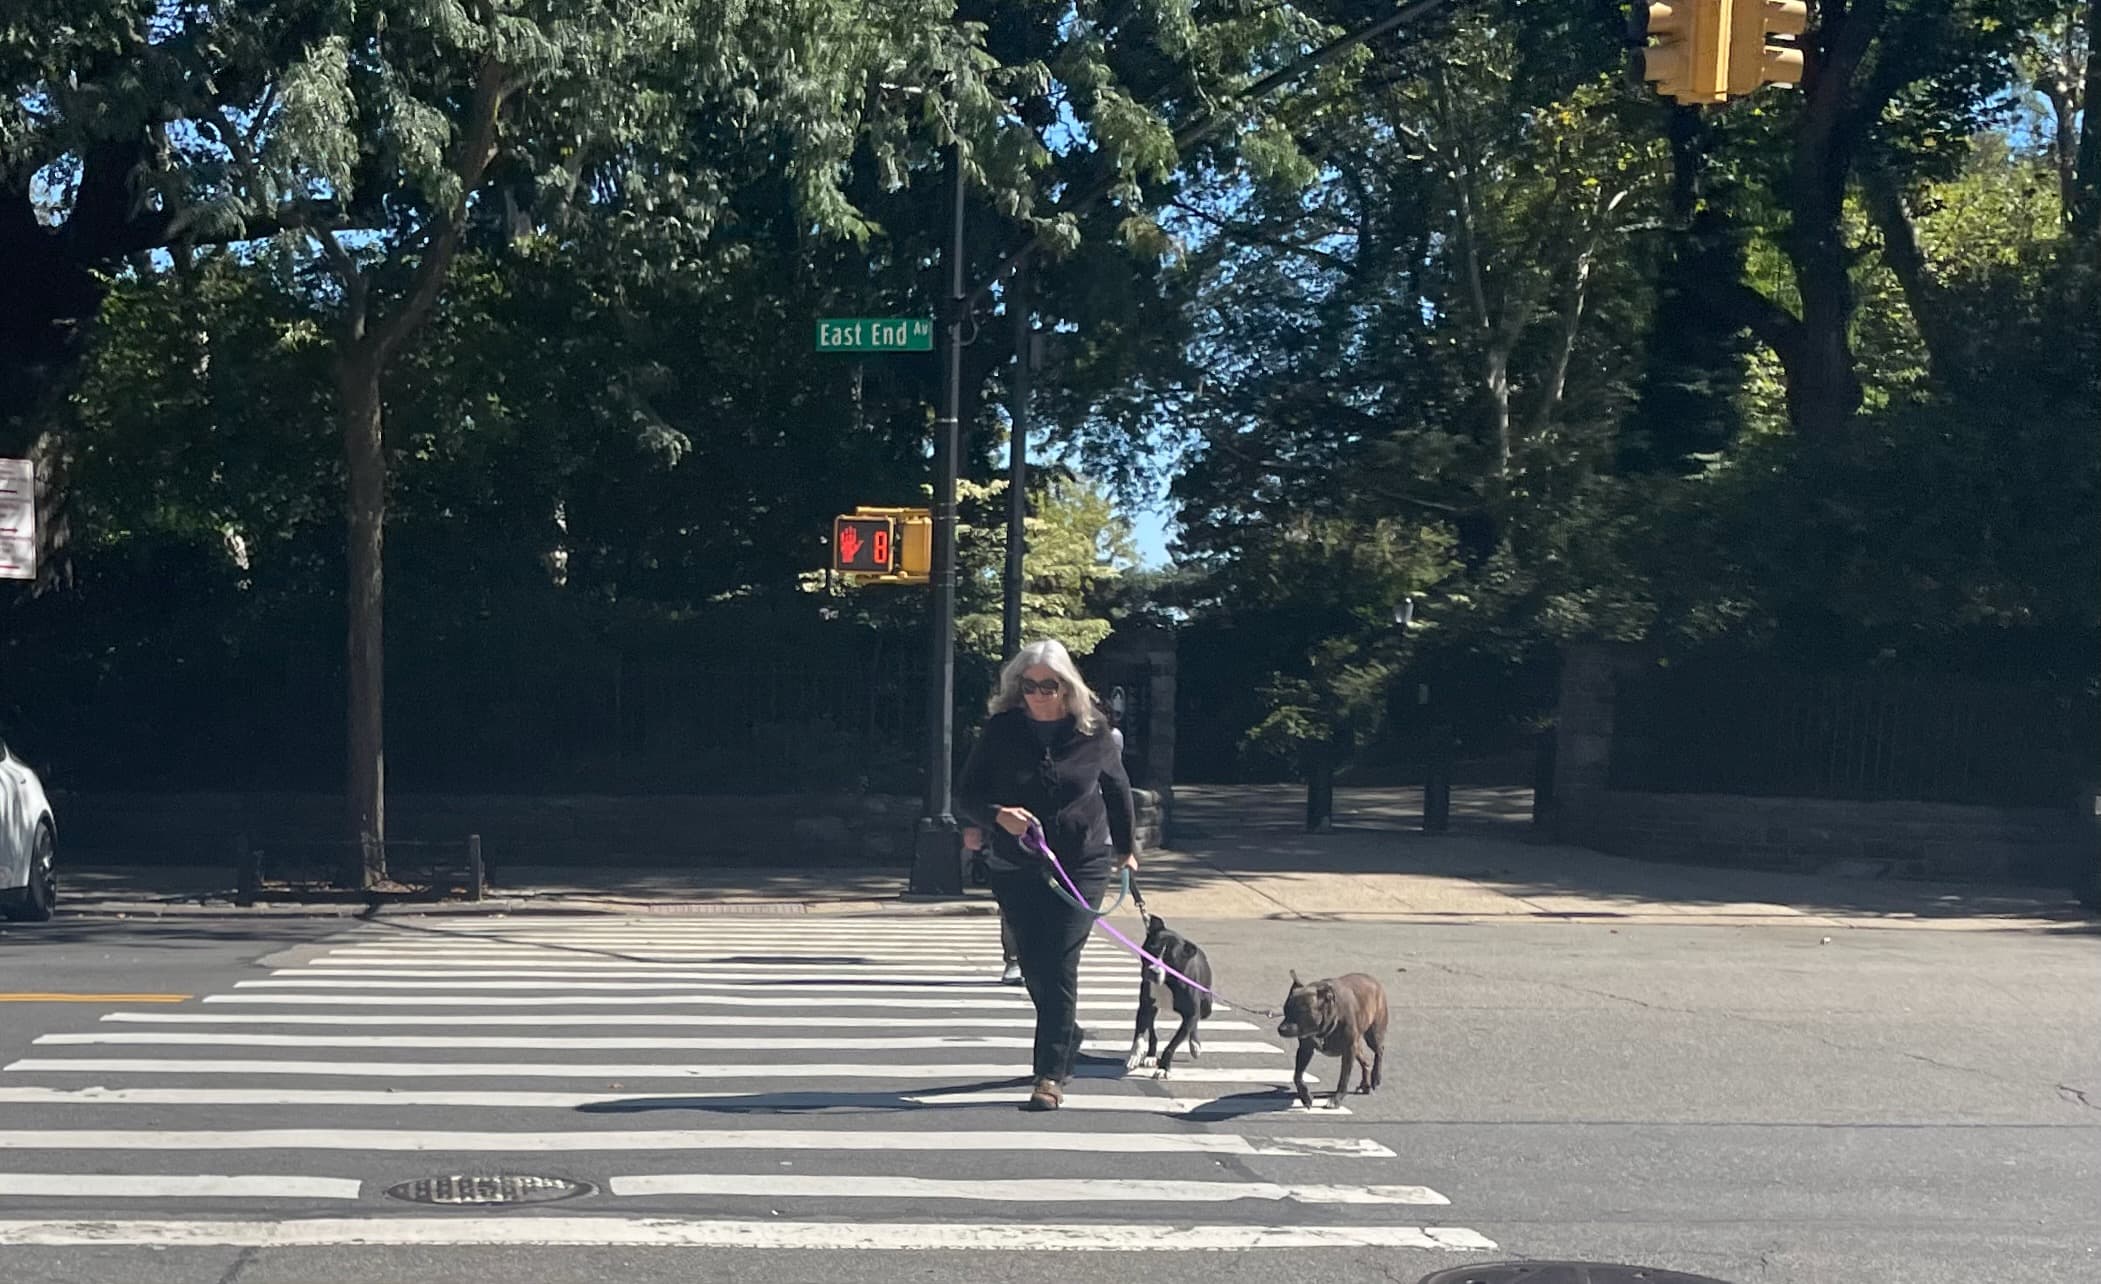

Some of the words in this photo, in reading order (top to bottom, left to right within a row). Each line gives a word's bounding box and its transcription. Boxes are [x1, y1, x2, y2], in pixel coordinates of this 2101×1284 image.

[820, 322, 862, 346] East
[871, 321, 907, 346] End
[874, 531, 888, 563] 8
